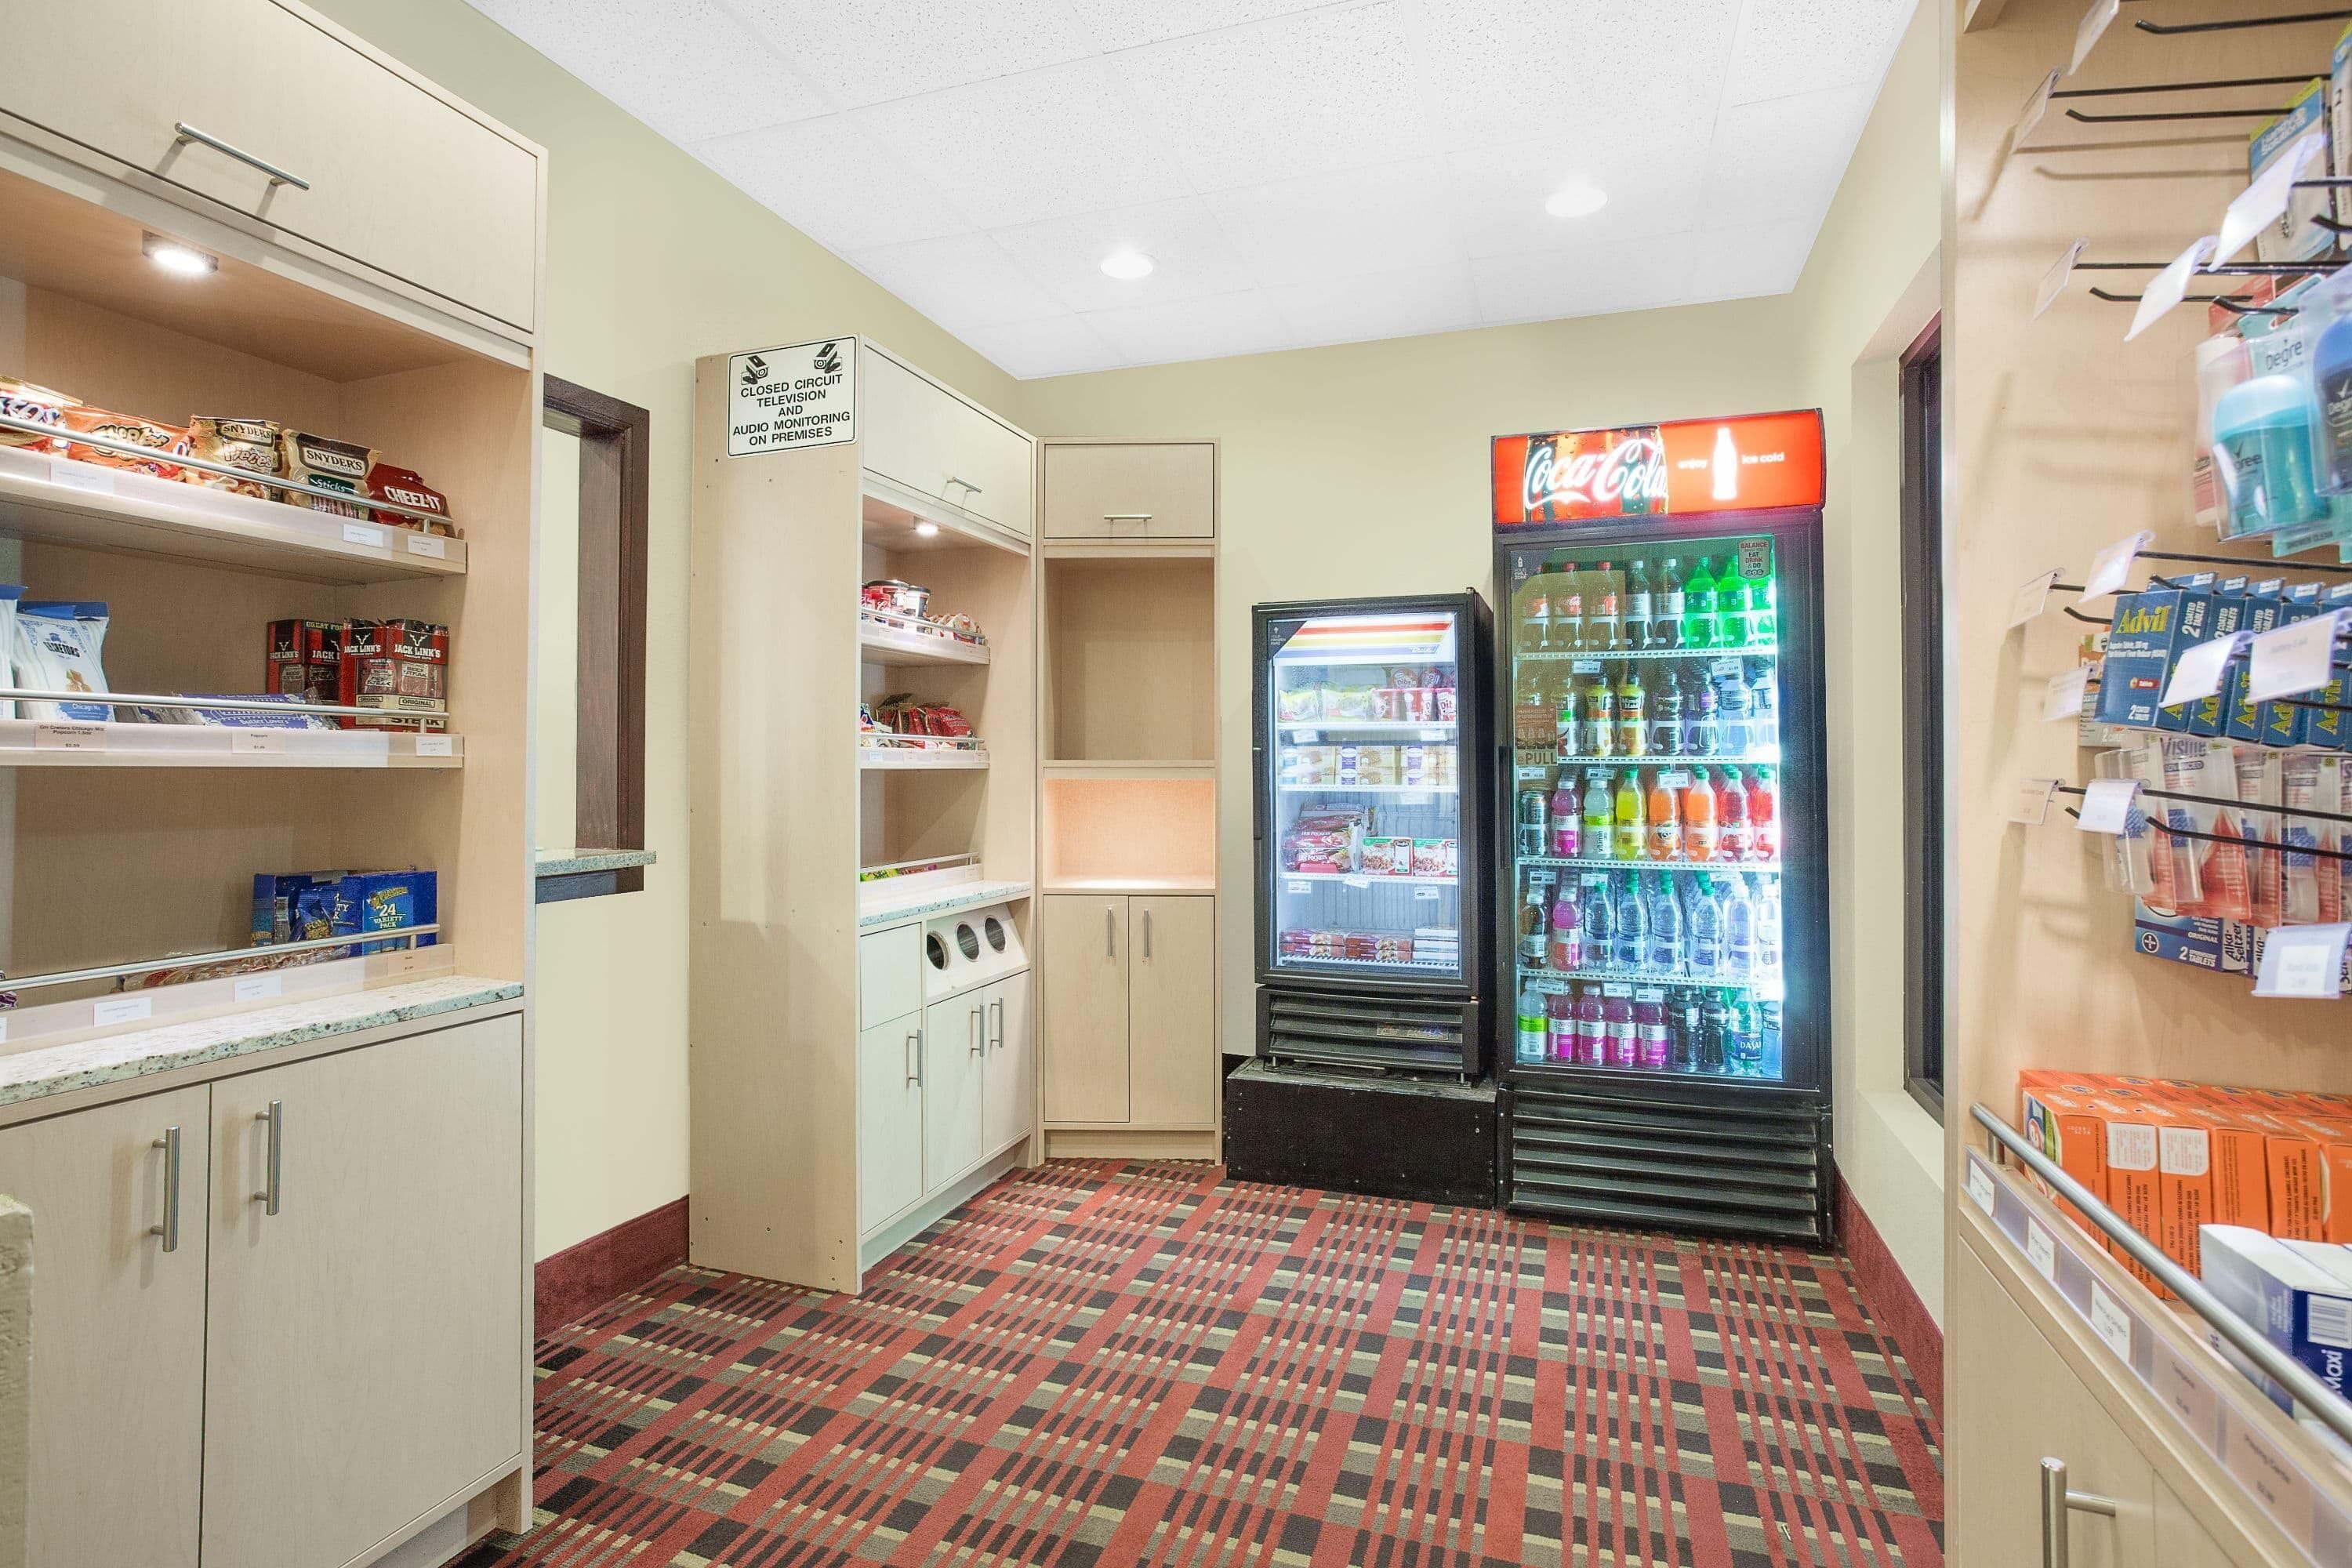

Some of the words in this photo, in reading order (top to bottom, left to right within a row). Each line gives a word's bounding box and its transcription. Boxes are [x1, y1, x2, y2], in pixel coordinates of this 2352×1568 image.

[2266, 340, 2303, 371] Degre
[740, 382, 789, 397] CLOSED
[794, 373, 843, 390] CIRCUIT
[757, 389, 826, 408] TELEVISION
[778, 405, 804, 417] AND
[732, 422, 769, 436] AUDIO
[774, 411, 851, 431] MONITORING
[749, 435, 767, 446] ON
[771, 426, 833, 443] PREMISES
[223, 443, 272, 468] Pieces
[306, 449, 363, 470] SNYDER'S
[1677, 457, 1708, 470] enjoy
[1741, 454, 1758, 464] ice
[1759, 452, 1785, 463] cold
[1524, 437, 1668, 510] Coca-Cola
[316, 479, 346, 493] Sticks
[383, 486, 440, 511] CHEEZ-IT
[2115, 604, 2172, 633] Advil
[2186, 602, 2197, 626] COATED
[2194, 601, 2206, 628] TABLETS
[2217, 608, 2229, 631] COATED
[2225, 607, 2238, 633] TABLETS
[2252, 609, 2264, 633] COATED
[2181, 620, 2201, 638] 2
[312, 650, 335, 659] JACK
[394, 644, 416, 654] JACK
[418, 647, 441, 658] LINK'S
[2128, 704, 2137, 720] 2
[1525, 752, 1558, 764] PULL
[373, 915, 404, 924] VARIETY
[379, 903, 397, 917] 24
[2187, 931, 2219, 943] ORIGINAL
[2224, 930, 2236, 961] Alka-
[2233, 923, 2246, 964] Seltzer
[2179, 946, 2189, 960] 2
[2188, 954, 2216, 967] TABLETS
[2320, 1348, 2344, 1395] Maxi
